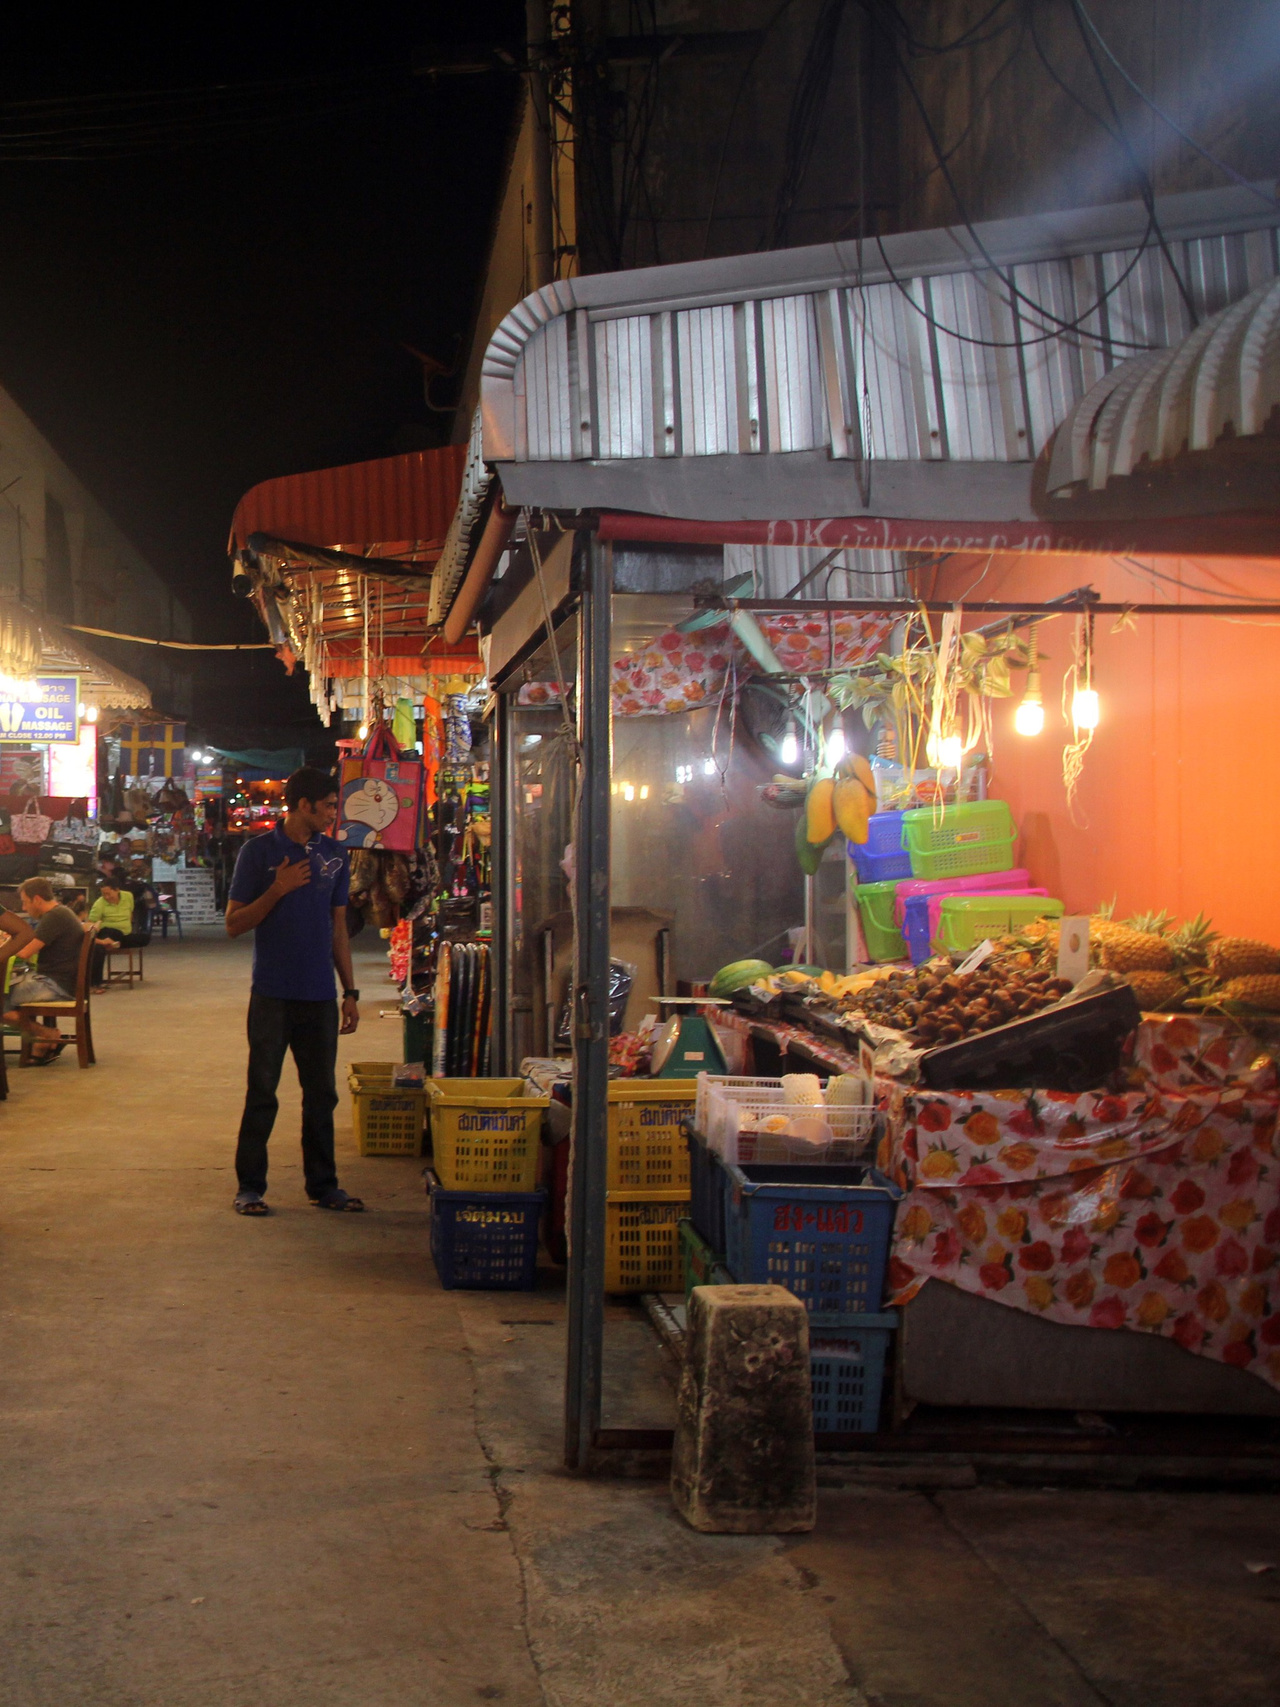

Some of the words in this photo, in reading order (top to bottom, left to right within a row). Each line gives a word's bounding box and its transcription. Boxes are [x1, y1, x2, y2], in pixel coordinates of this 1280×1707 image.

[19, 694, 71, 704] MASAGE
[34, 707, 64, 719] OIL
[21, 721, 73, 731] MASSAGE
